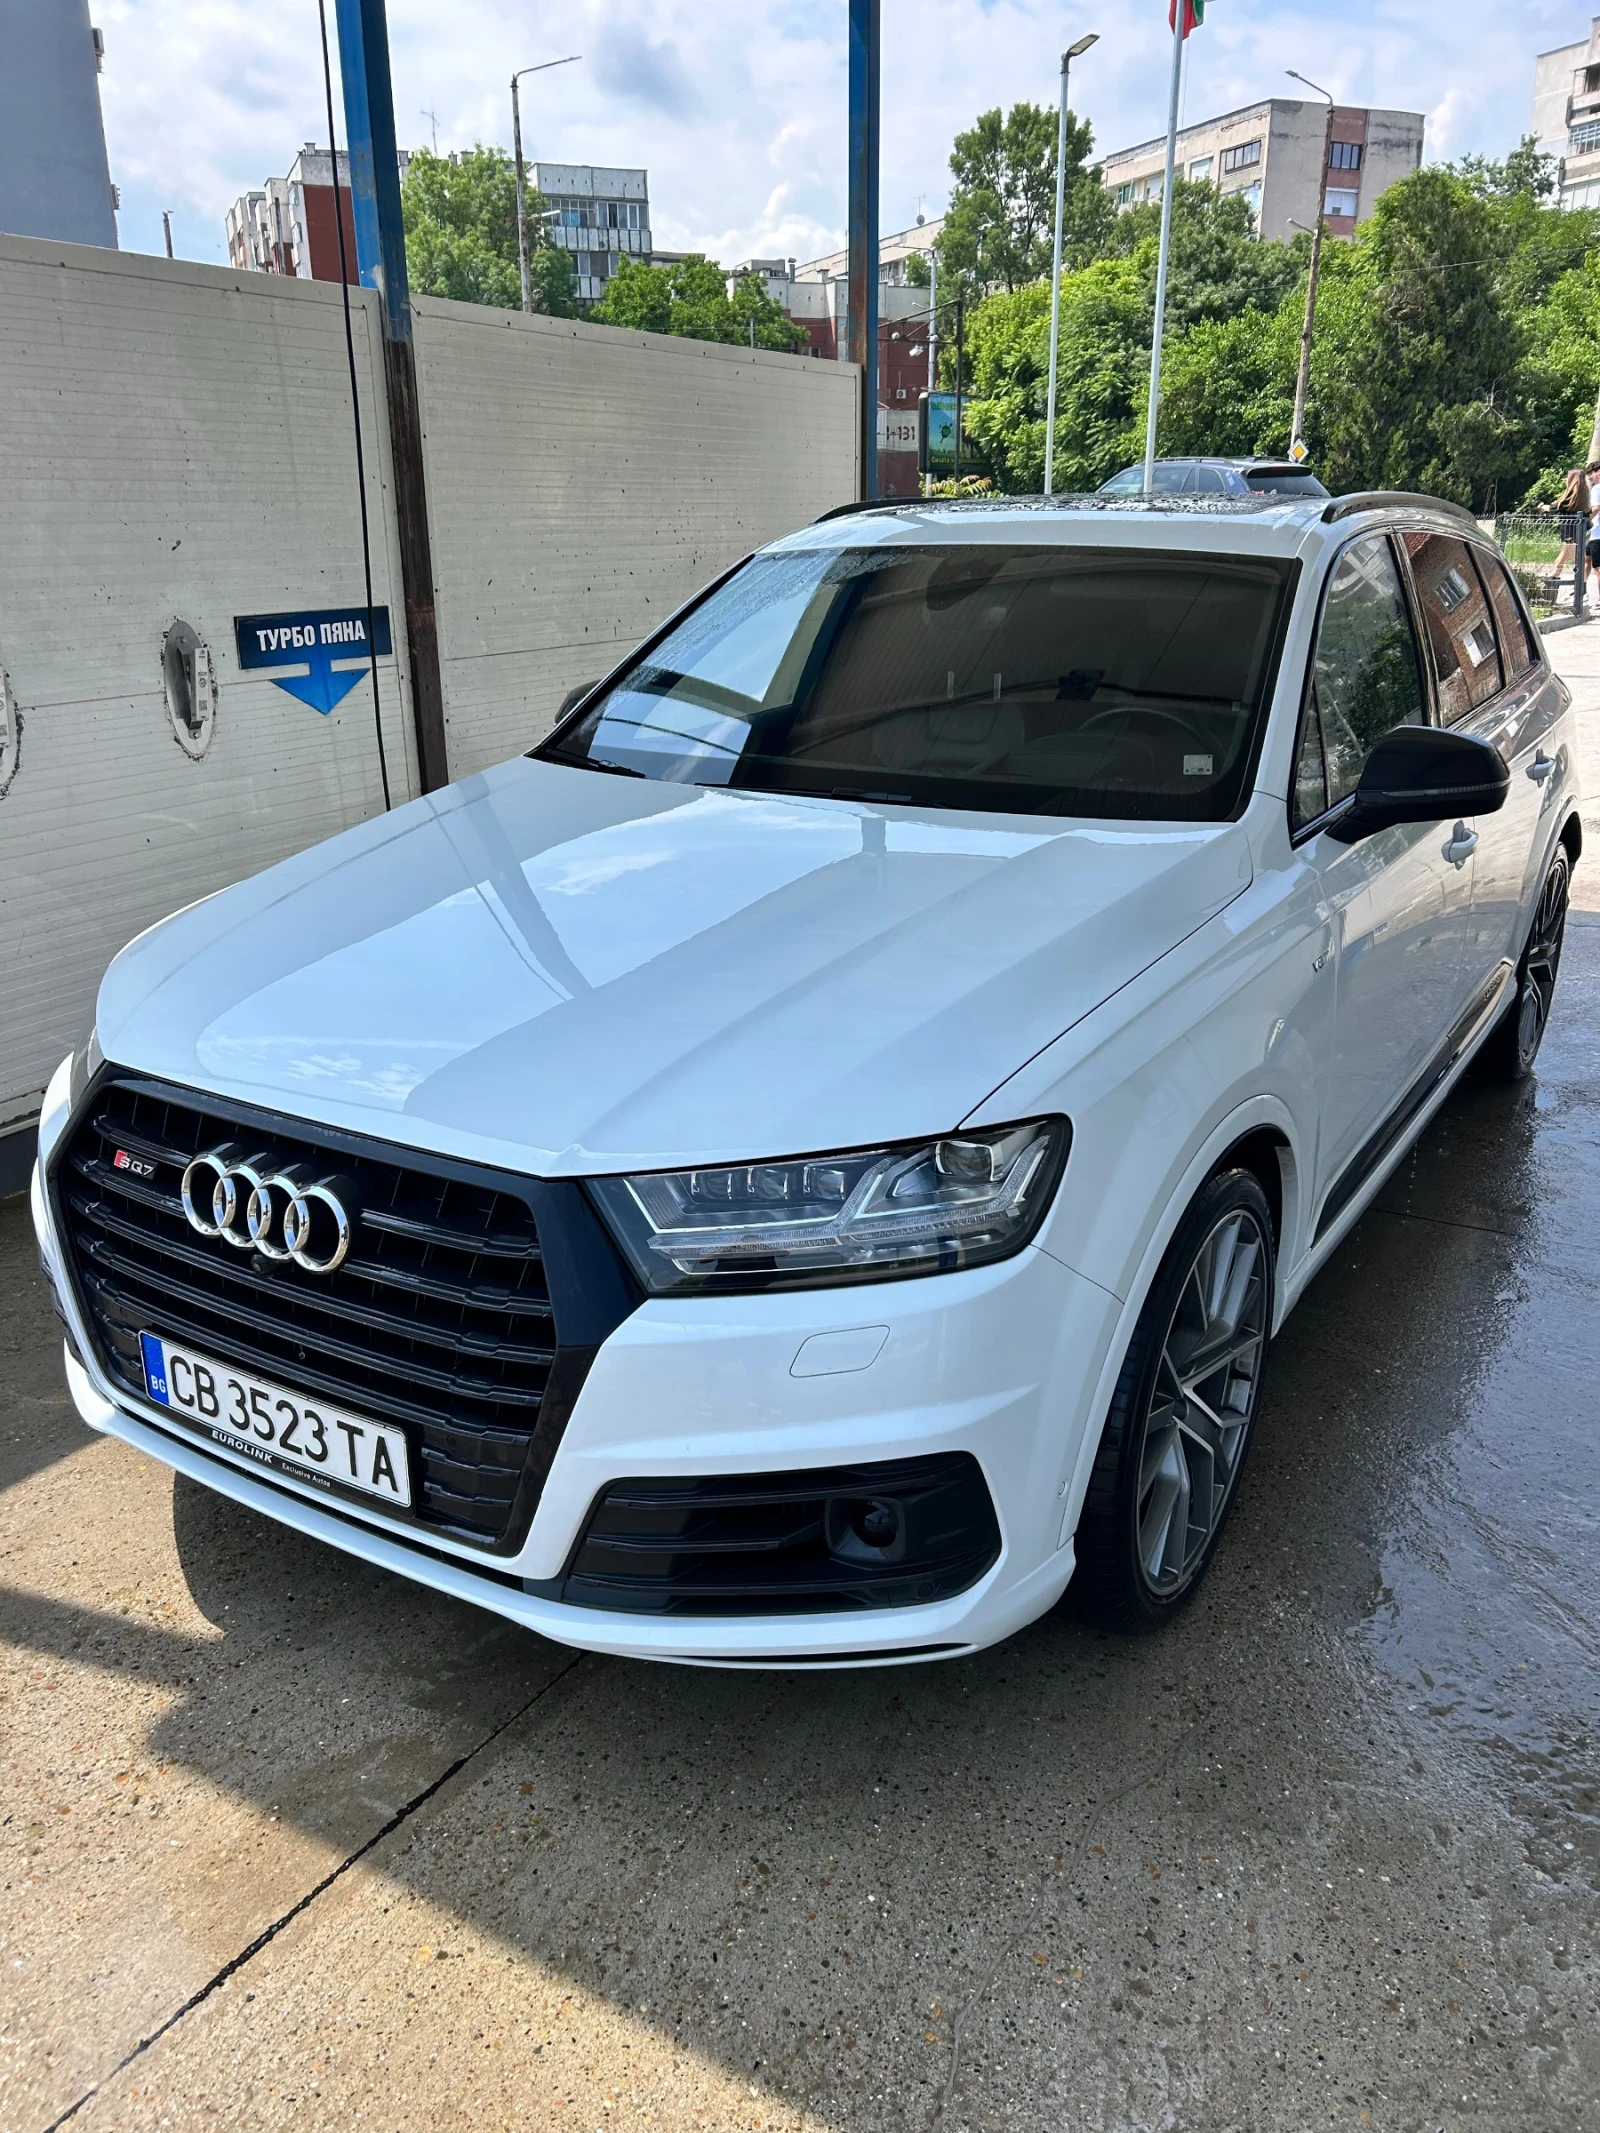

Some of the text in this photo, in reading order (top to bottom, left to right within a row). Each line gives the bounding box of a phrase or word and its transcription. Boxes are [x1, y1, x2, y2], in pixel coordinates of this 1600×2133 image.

[256, 619, 367, 652] ТУРБО ПЯНА
[117, 1154, 154, 1176] SQ7
[150, 1374, 167, 1394] BG
[170, 1354, 400, 1494] CB 3523 TA
[211, 1429, 274, 1464] EUROLINK
[281, 1462, 311, 1480] Exclusive
